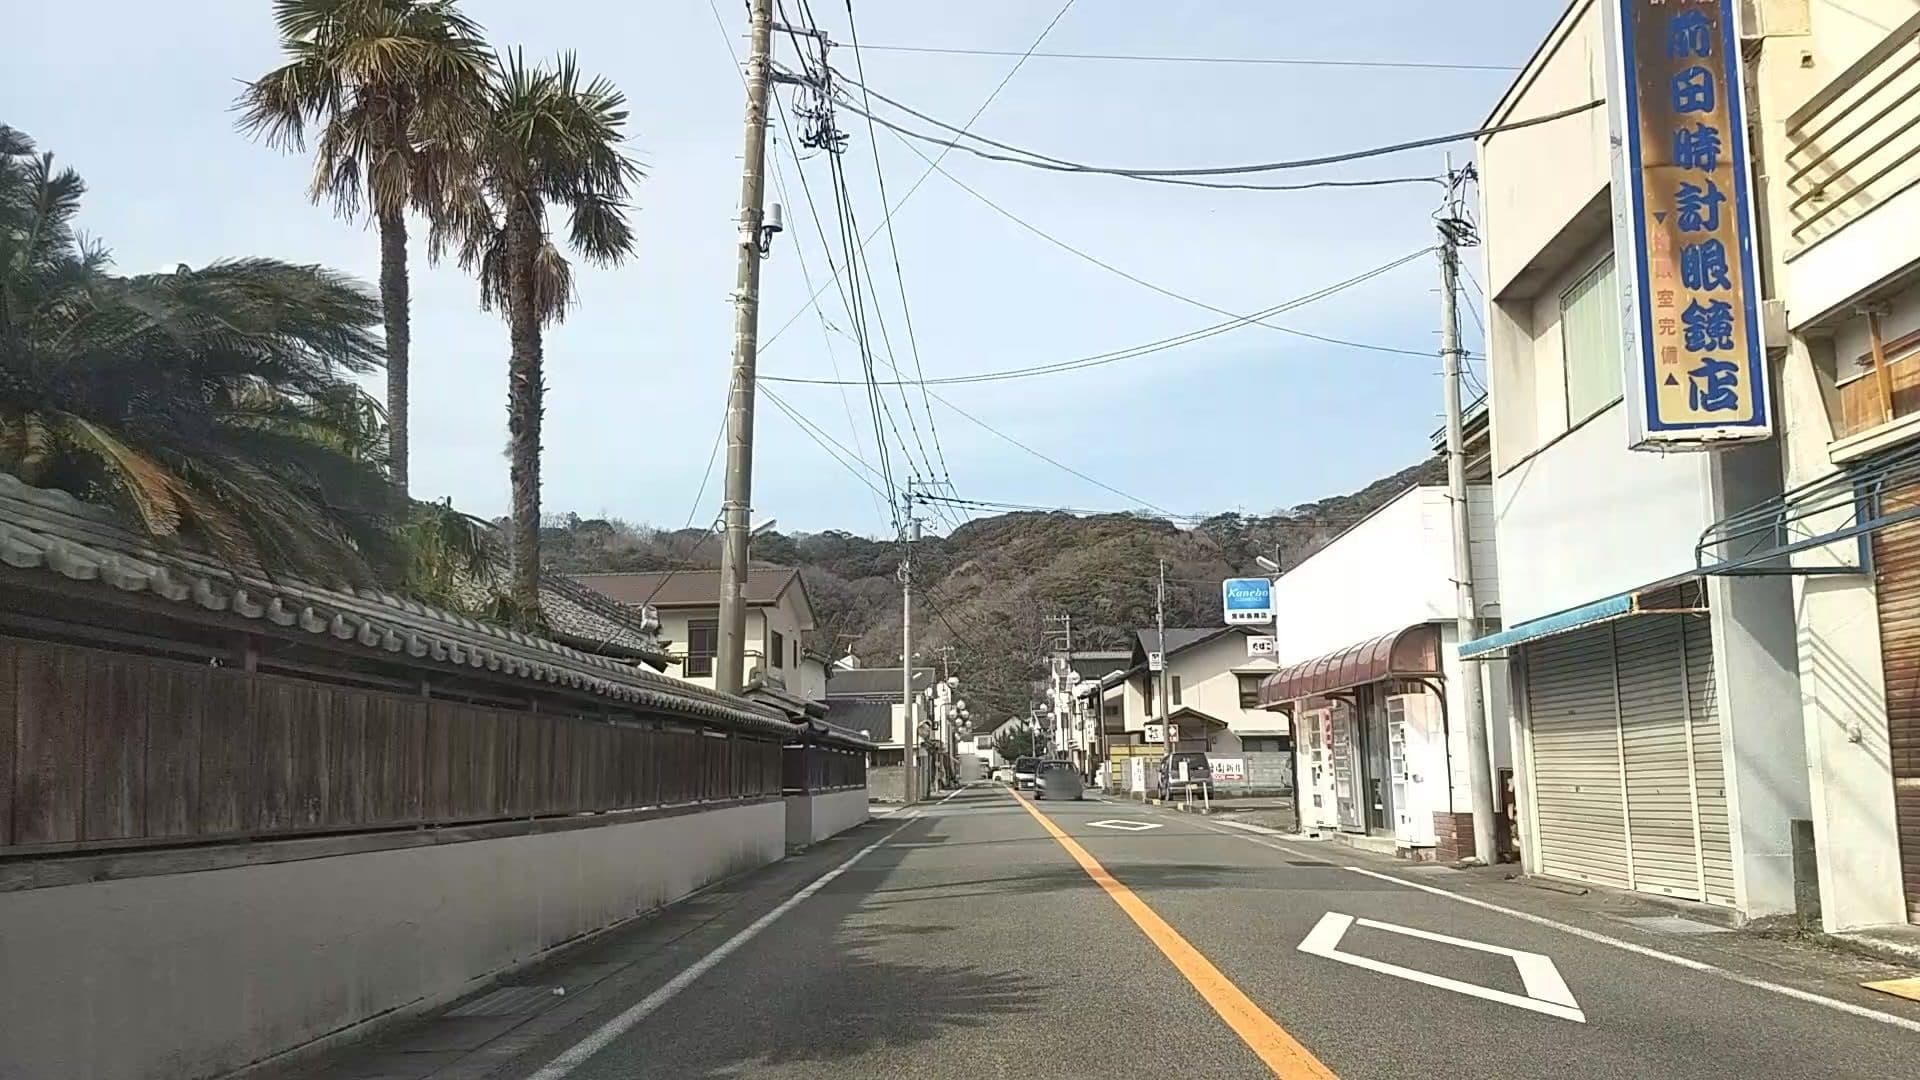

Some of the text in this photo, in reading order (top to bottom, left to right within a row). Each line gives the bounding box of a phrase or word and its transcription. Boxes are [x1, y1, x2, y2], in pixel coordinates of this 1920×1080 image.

[1667, 10, 1739, 411] 前田時計眼鏡店
[1228, 587, 1268, 598] Kanebo
